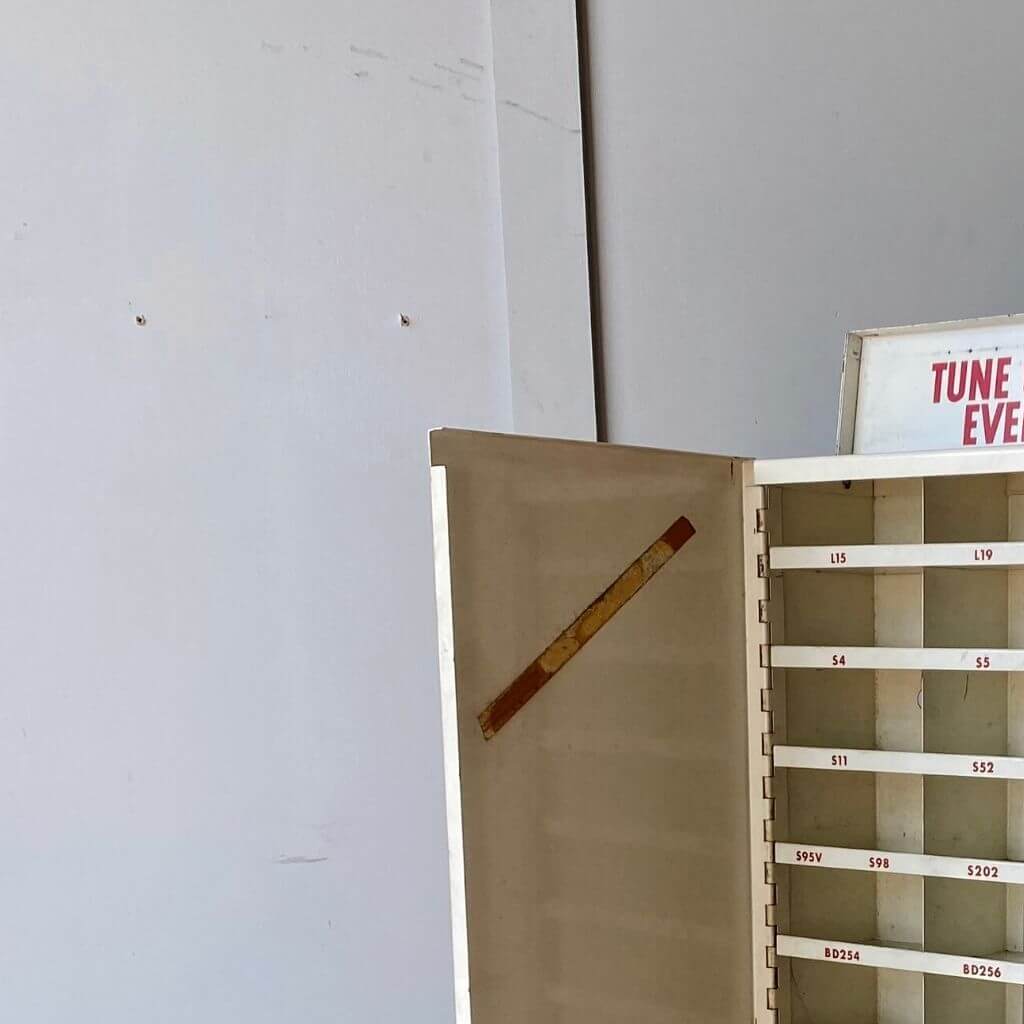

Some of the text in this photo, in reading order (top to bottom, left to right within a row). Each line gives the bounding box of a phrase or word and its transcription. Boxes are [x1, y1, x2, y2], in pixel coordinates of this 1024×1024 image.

[932, 357, 1012, 403] TUNE
[830, 552, 847, 564] L15
[974, 549, 993, 561] L19
[832, 655, 846, 666] S4
[975, 657, 990, 668] S5
[831, 755, 847, 766] S11
[972, 762, 994, 774] S52
[795, 850, 823, 863] S95V
[869, 857, 890, 869] S98
[967, 865, 999, 878] S202
[824, 947, 860, 961] BD254
[963, 964, 1001, 978] BD256
